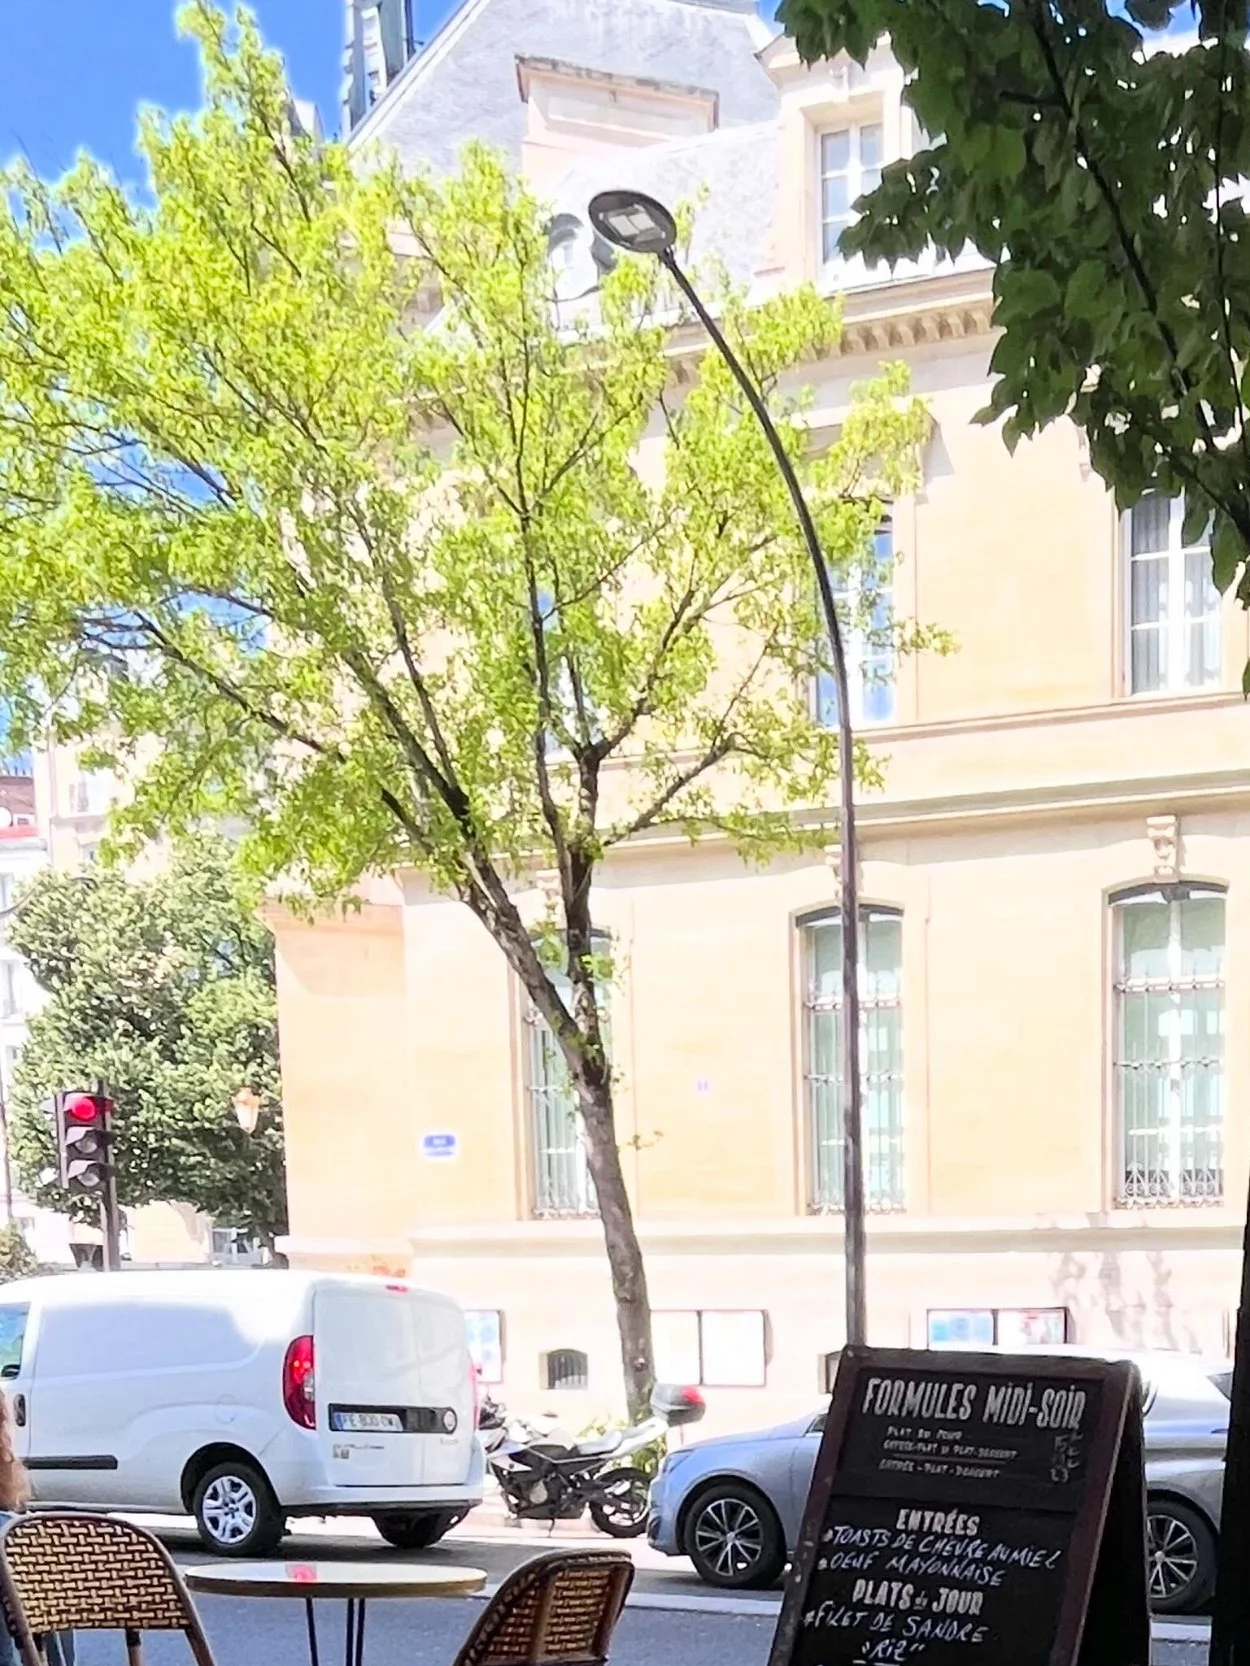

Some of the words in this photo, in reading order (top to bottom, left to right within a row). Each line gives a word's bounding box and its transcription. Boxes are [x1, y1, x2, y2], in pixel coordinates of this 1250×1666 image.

[862, 1377, 977, 1420] FORMULES
[897, 1508, 980, 1537] ENTRÉES
[834, 1526, 891, 1548] TOASTS
[892, 1534, 916, 1550] DE
[830, 1551, 880, 1570] OEUF
[852, 1579, 915, 1610] PLATS
[931, 1587, 984, 1615] JOUR
[869, 1612, 893, 1632] DE
[902, 1616, 990, 1643] SANDRE
